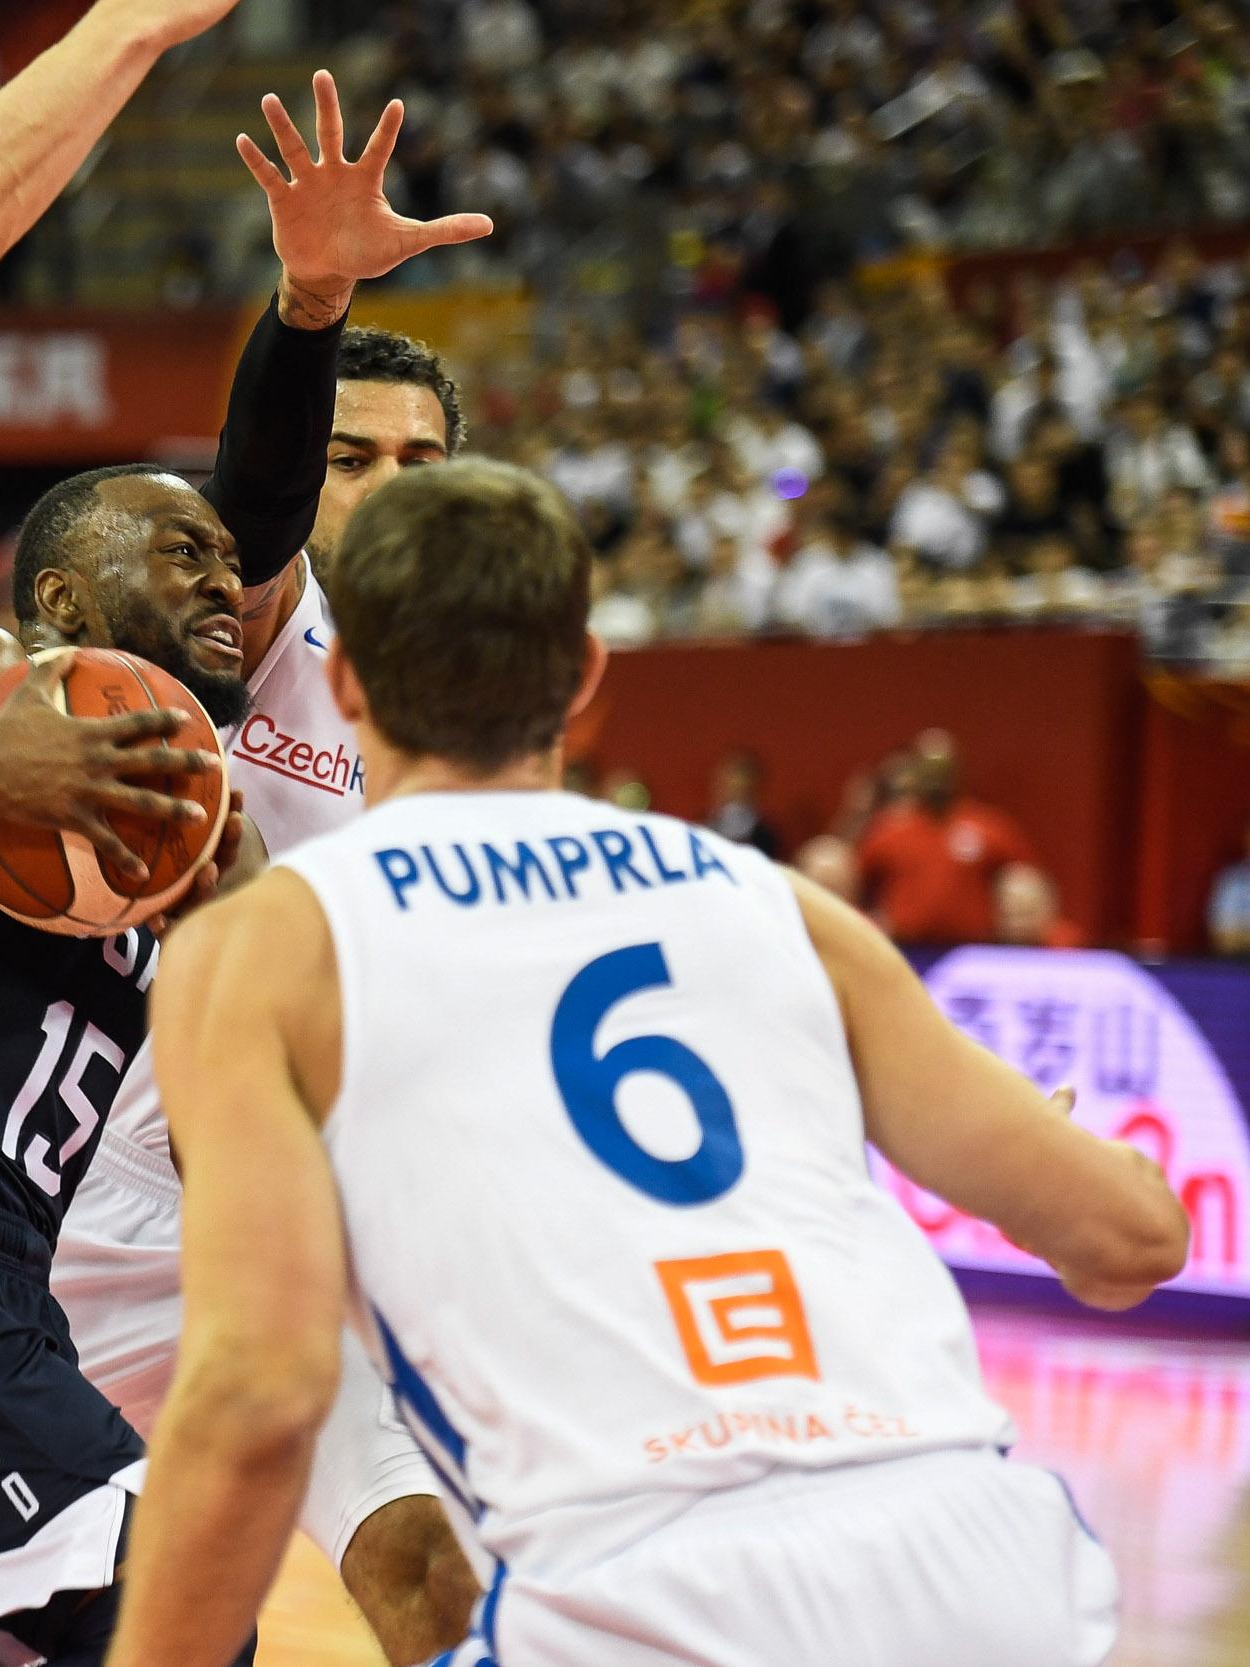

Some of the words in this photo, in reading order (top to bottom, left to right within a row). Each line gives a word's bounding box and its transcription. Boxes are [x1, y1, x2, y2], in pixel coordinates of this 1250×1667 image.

[373, 824, 740, 910] PUMPRLA
[0, 999, 127, 1198] 15
[549, 941, 746, 1210] 6
